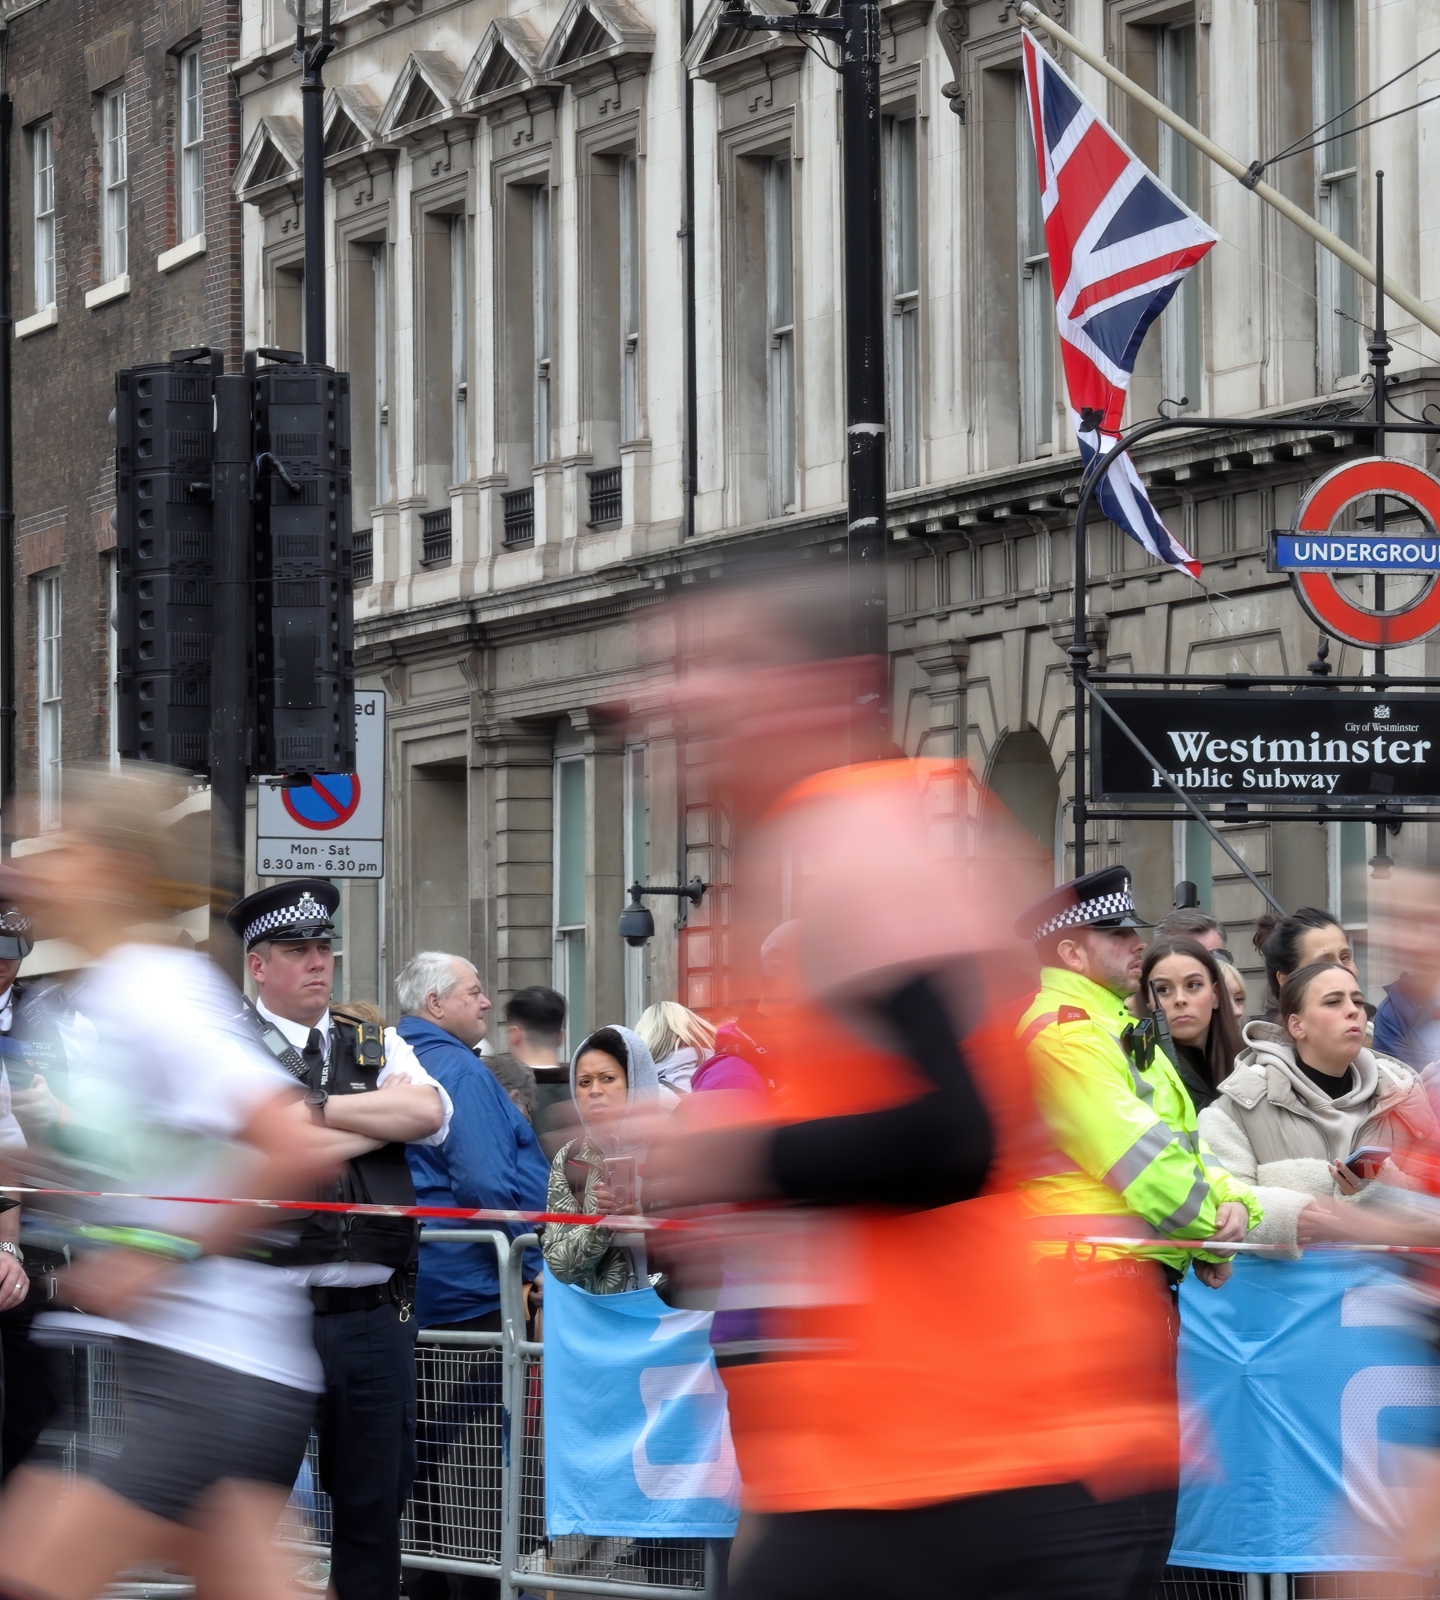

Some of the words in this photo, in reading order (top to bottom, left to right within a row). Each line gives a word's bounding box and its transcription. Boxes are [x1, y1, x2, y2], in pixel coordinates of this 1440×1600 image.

[1345, 722, 1360, 734] City
[1361, 722, 1371, 732] of
[1372, 722, 1419, 732] Westminster
[1167, 731, 1431, 763] Westminster
[1242, 768, 1340, 794] Subway
[290, 844, 318, 855] Mon
[328, 844, 350, 856] Sat
[263, 859, 293, 870] 8.30
[296, 861, 315, 870] am
[325, 860, 355, 871] 6.30
[358, 862, 378, 873] pm
